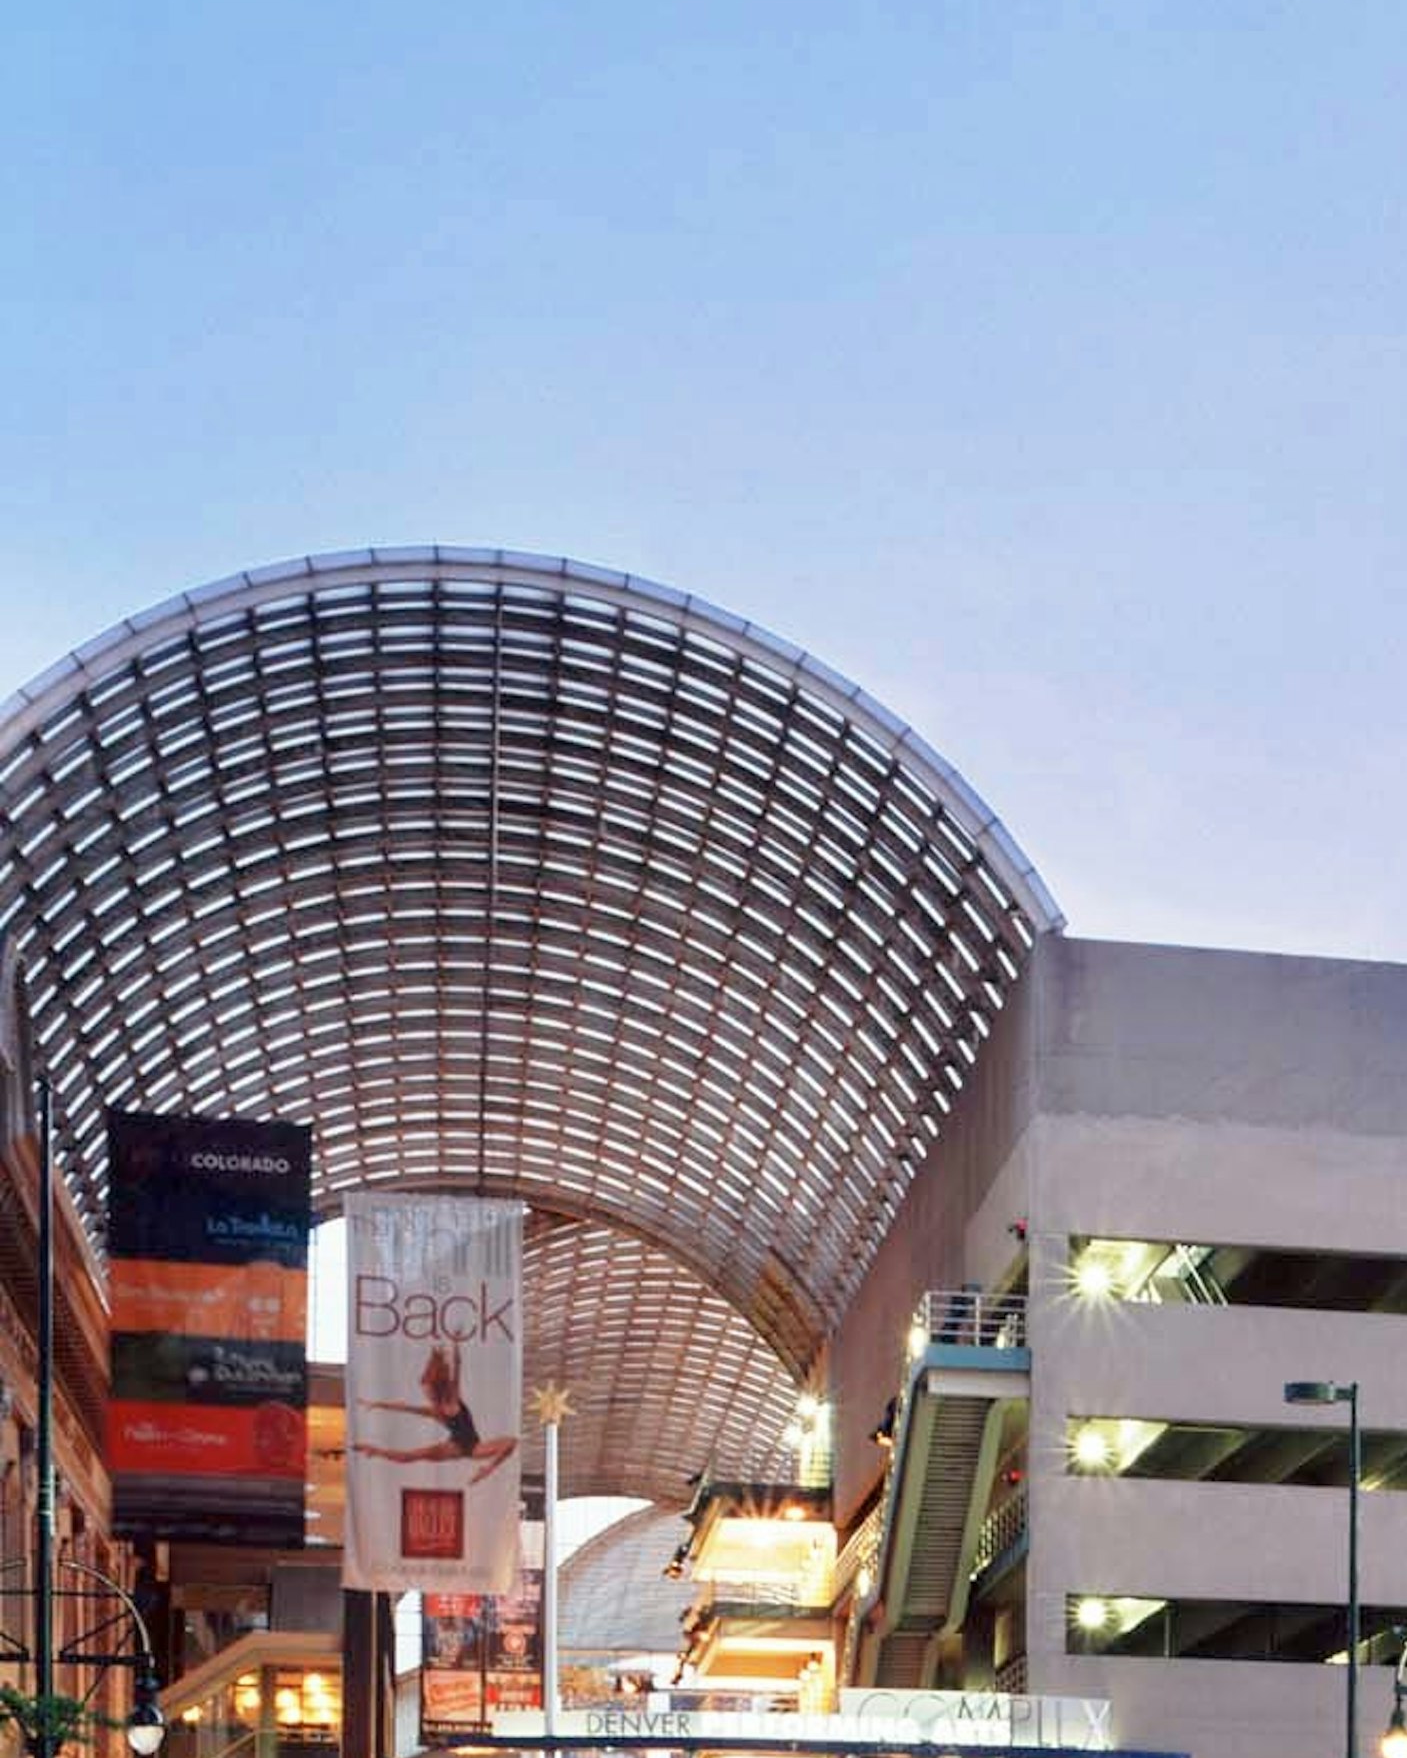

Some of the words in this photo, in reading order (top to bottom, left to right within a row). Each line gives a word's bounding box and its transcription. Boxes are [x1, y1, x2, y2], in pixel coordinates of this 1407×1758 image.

[190, 1154, 291, 1174] COLORADO
[355, 1274, 514, 1342] Back
[586, 1713, 691, 1736] DENVER
